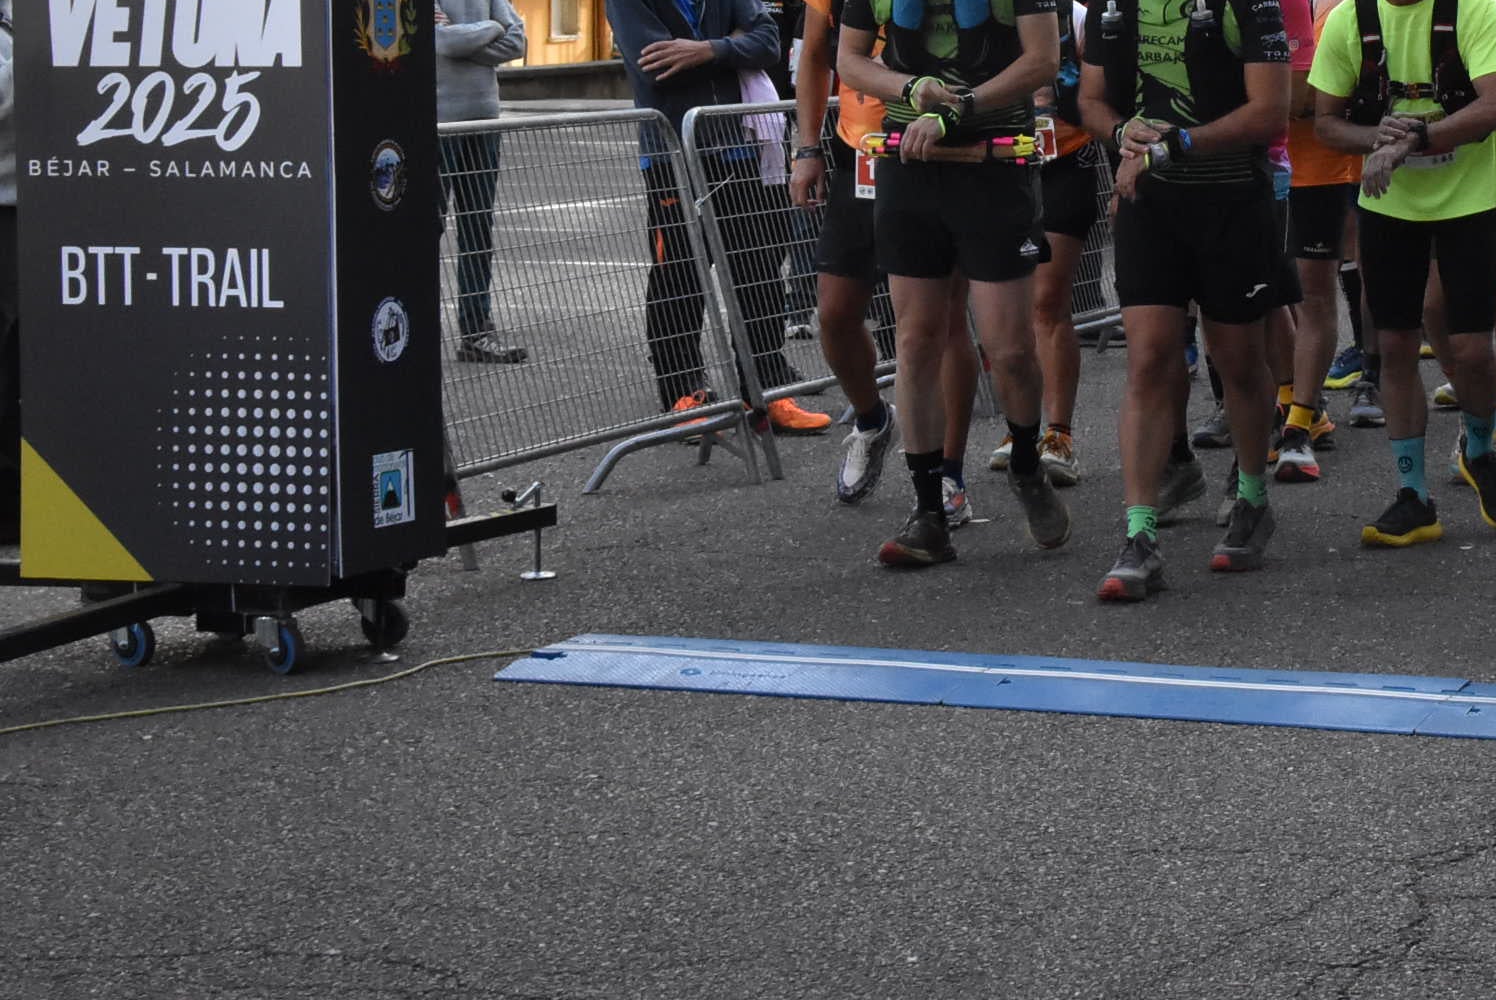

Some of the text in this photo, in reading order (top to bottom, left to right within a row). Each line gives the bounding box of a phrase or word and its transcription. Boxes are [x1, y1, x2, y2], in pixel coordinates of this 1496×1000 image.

[76, 70, 261, 151] 2025
[29, 156, 110, 177] BÉJAR
[150, 161, 312, 178] SALAMANCA
